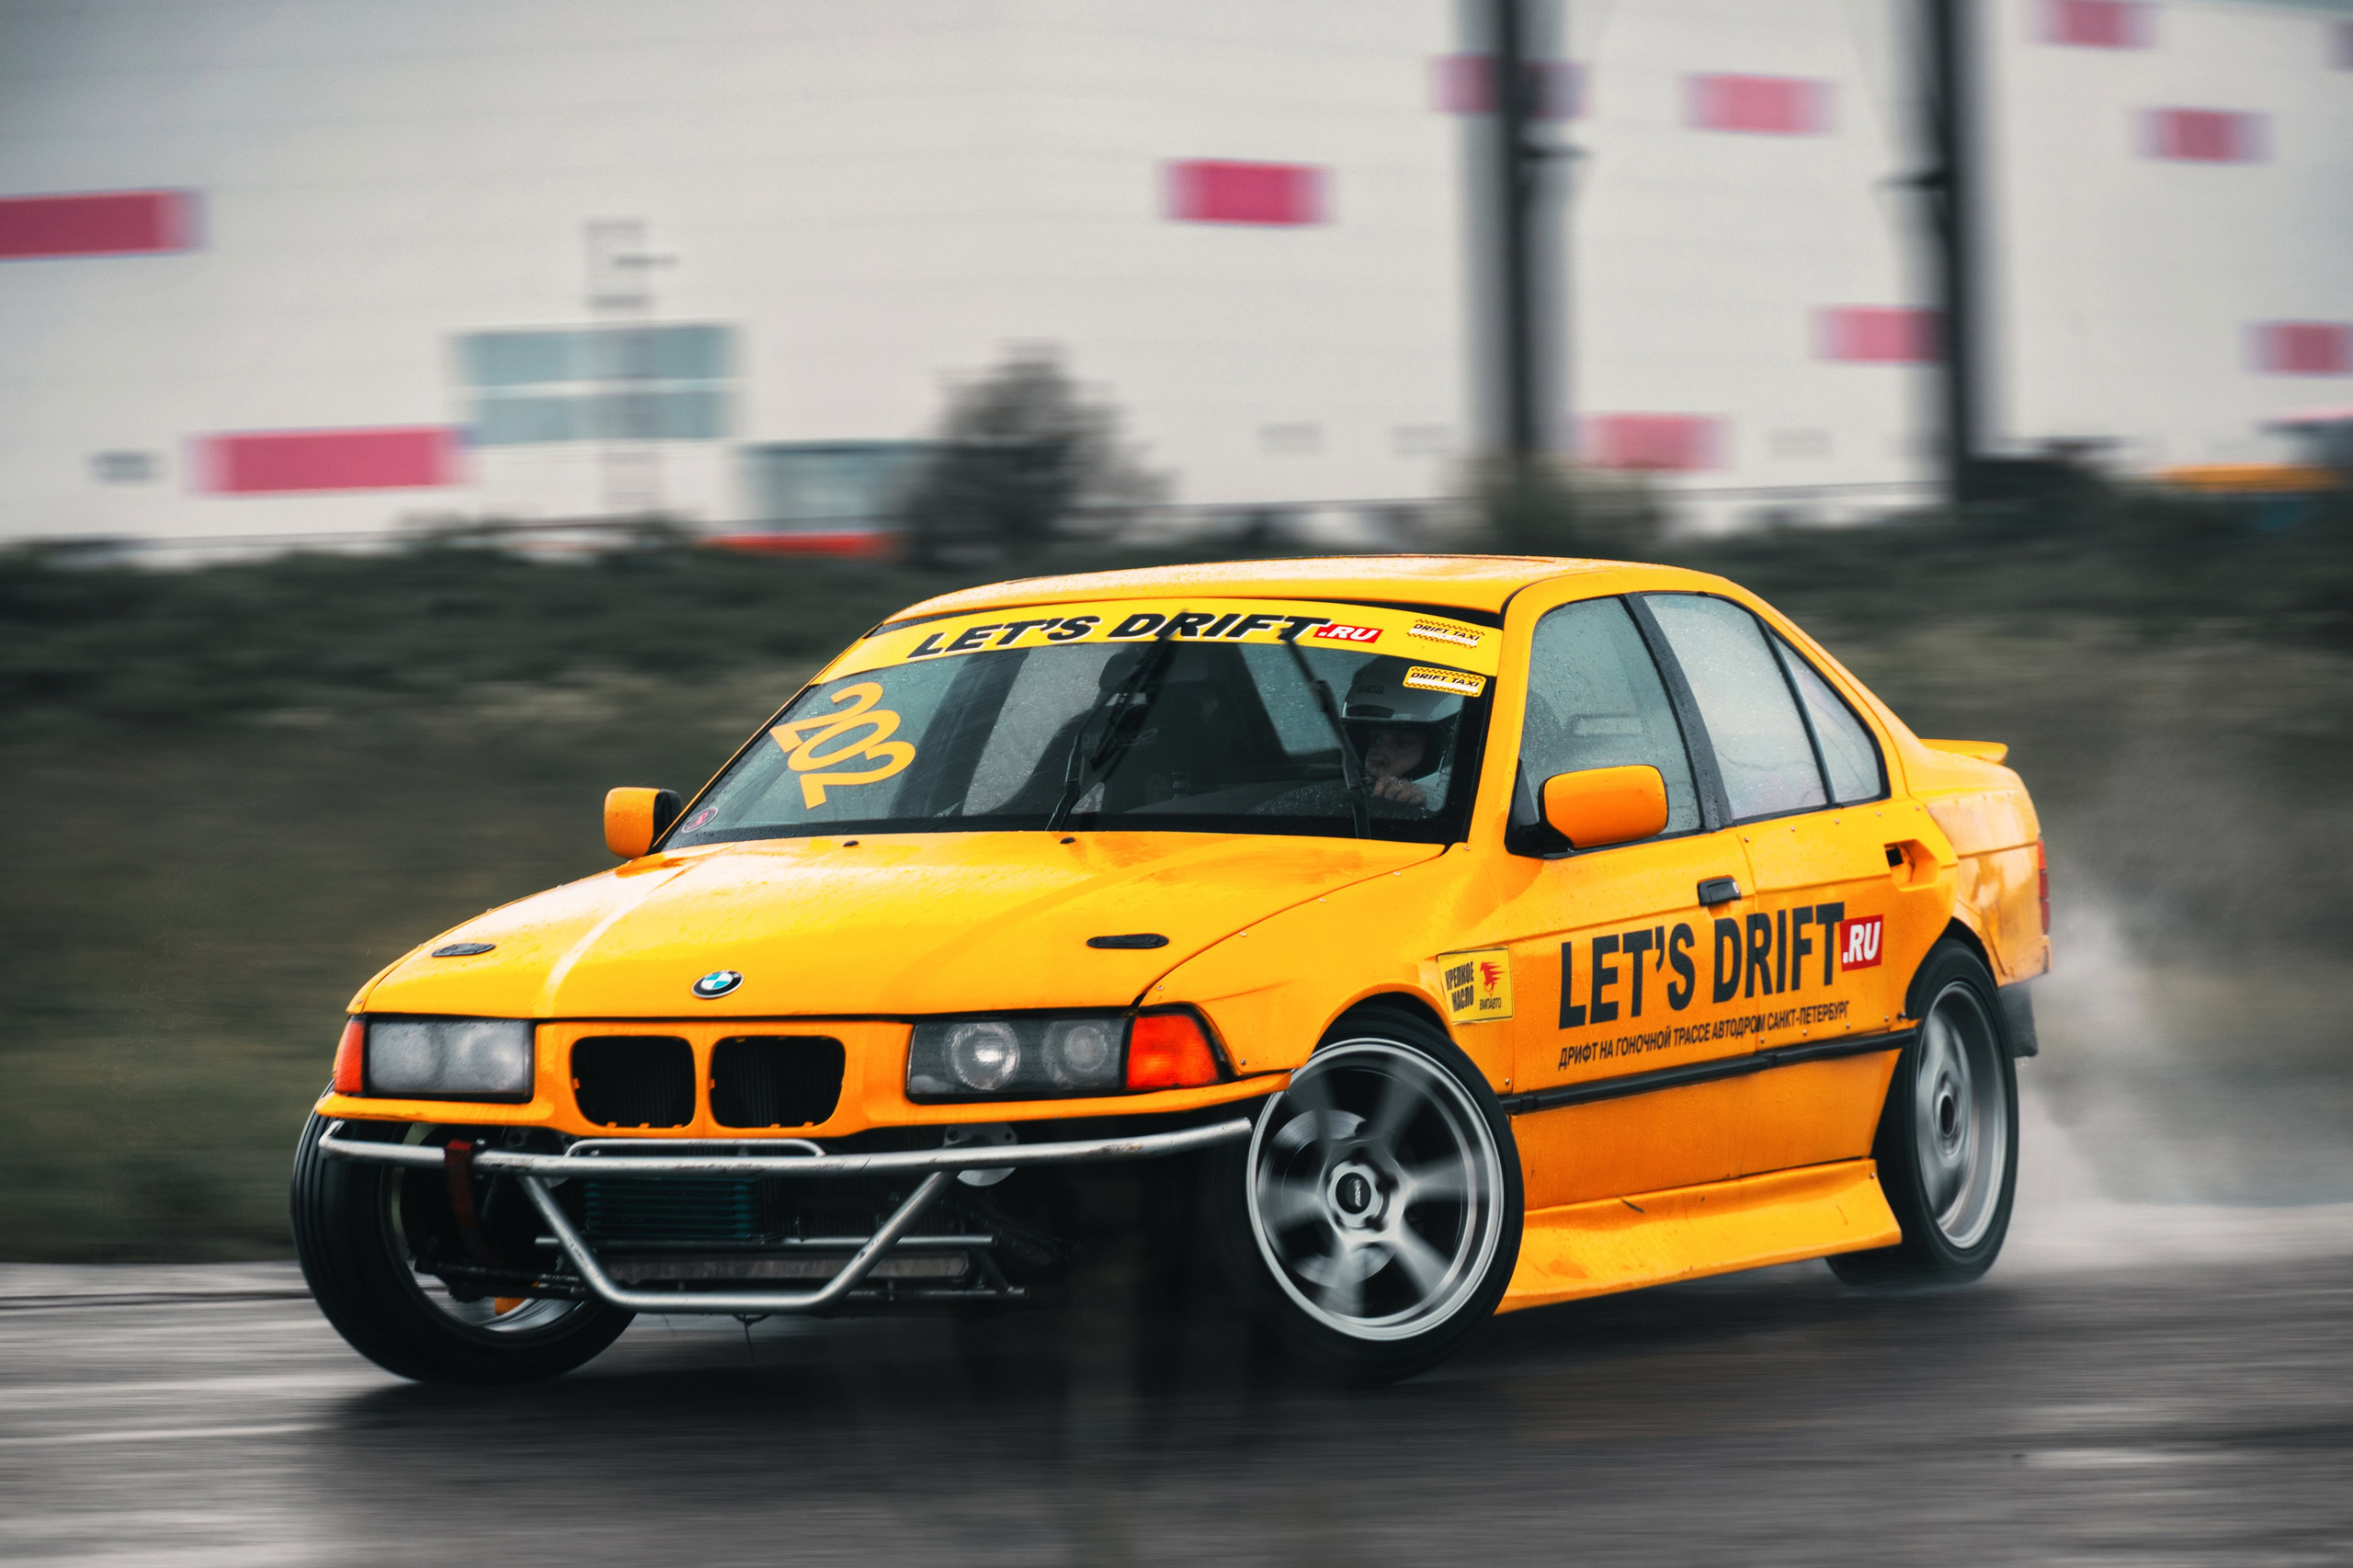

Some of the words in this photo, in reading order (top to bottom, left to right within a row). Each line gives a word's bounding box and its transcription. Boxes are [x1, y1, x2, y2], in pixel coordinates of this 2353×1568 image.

[907, 615, 1102, 660] LET'S
[1413, 623, 1450, 635] DRIFT
[1453, 631, 1481, 641] TAXI
[1410, 672, 1449, 682] DRIFT
[1451, 677, 1480, 687] TAXI
[768, 681, 916, 811] 202
[1559, 922, 1696, 1029] LET'S
[1451, 984, 1474, 1013] МАСЛО
[1558, 1041, 1598, 1072] ДРИФТ
[1599, 1040, 1614, 1060] НА
[1616, 1025, 1672, 1057] ГОНОЧНОЙ
[1674, 1022, 1711, 1047] ТРАССЕ
[1711, 1014, 1766, 1040] АВТОДРОМ
[1768, 999, 1850, 1030] САНКТ-ПЕТЕРБУРГ
